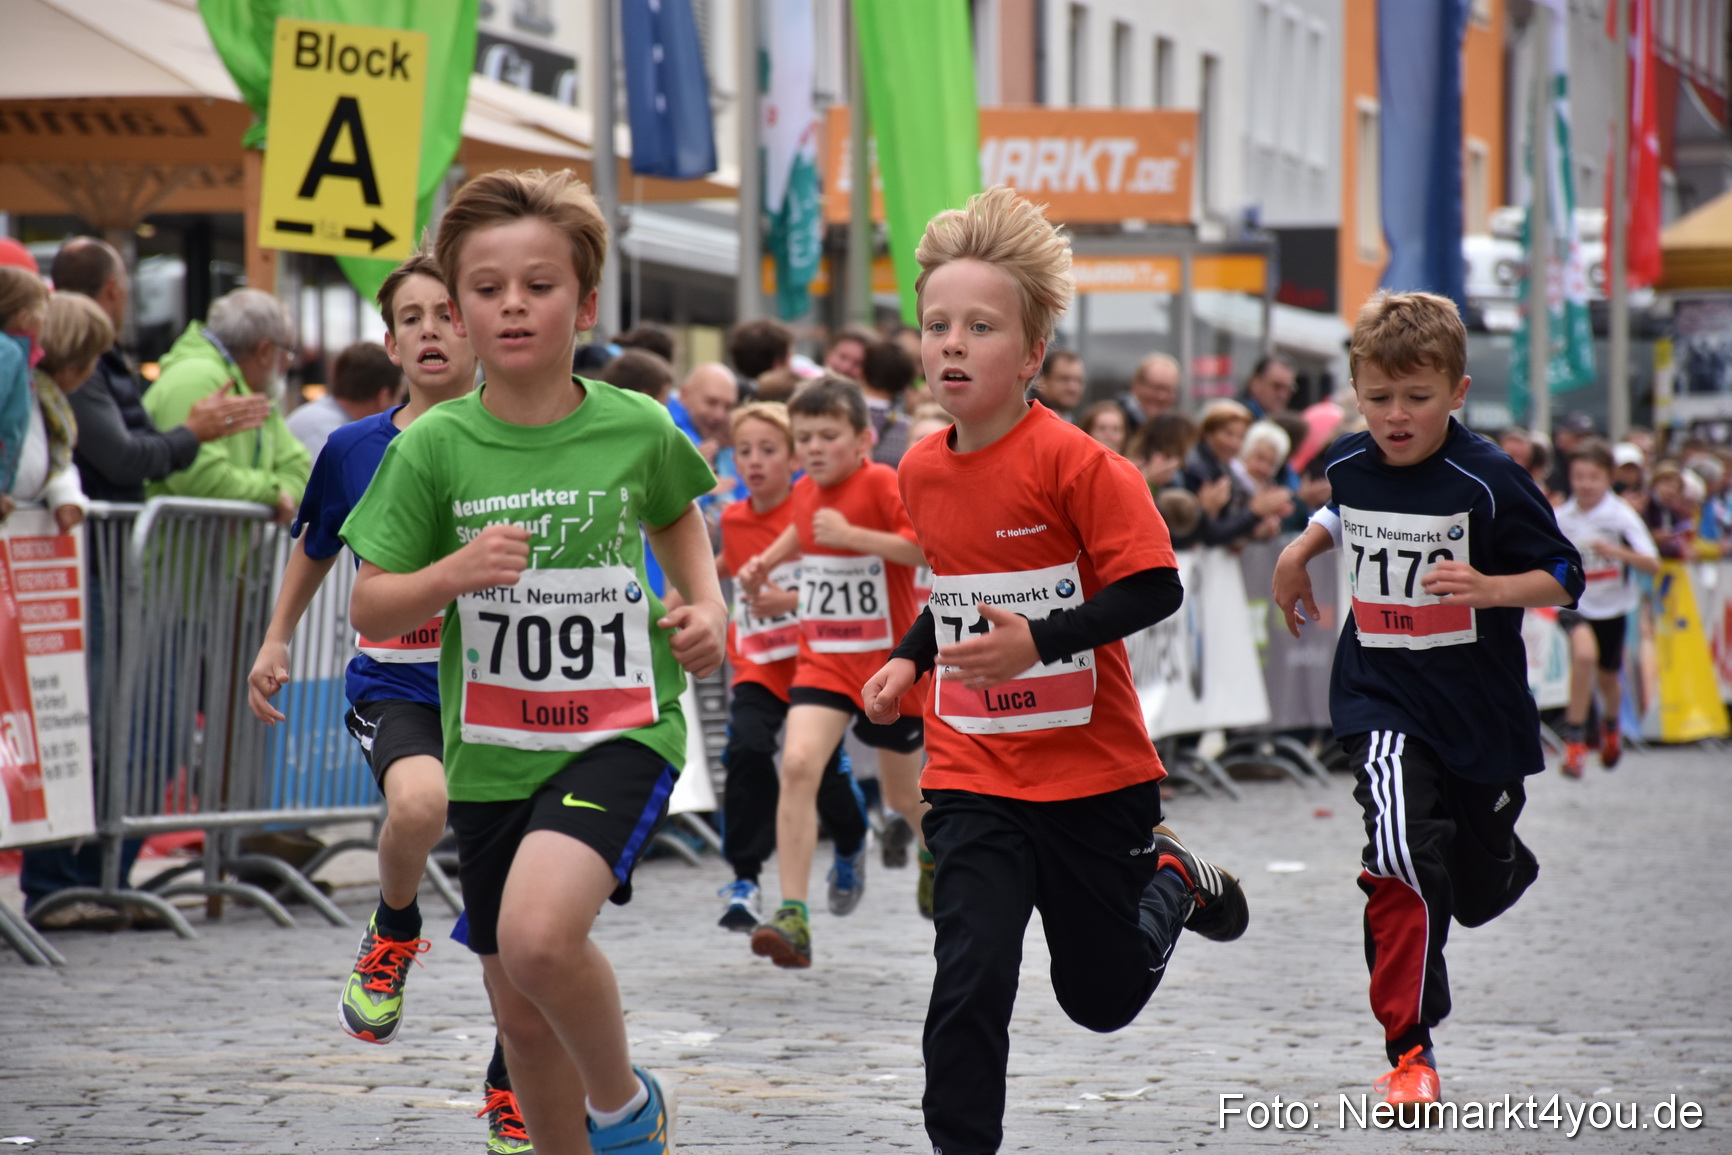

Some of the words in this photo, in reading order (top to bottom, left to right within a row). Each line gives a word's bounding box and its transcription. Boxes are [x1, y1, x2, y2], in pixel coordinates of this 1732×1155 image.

[294, 29, 412, 82] Block
[298, 95, 382, 208] A
[453, 488, 579, 518] Neumarkter
[996, 530, 1007, 539] FC
[1007, 524, 1047, 538] Holzheim
[1377, 526, 1442, 543] Neumarkt
[527, 588, 618, 604] Neumarkt
[806, 581, 878, 615] 7218
[971, 587, 1050, 606] Neumarkt
[1381, 610, 1414, 631] Tim
[478, 611, 627, 682] 7091
[1078, 657, 1086, 667] K
[471, 668, 478, 679] 6
[636, 675, 643, 684] K
[985, 690, 1036, 712] Luca
[522, 699, 589, 726] Louis
